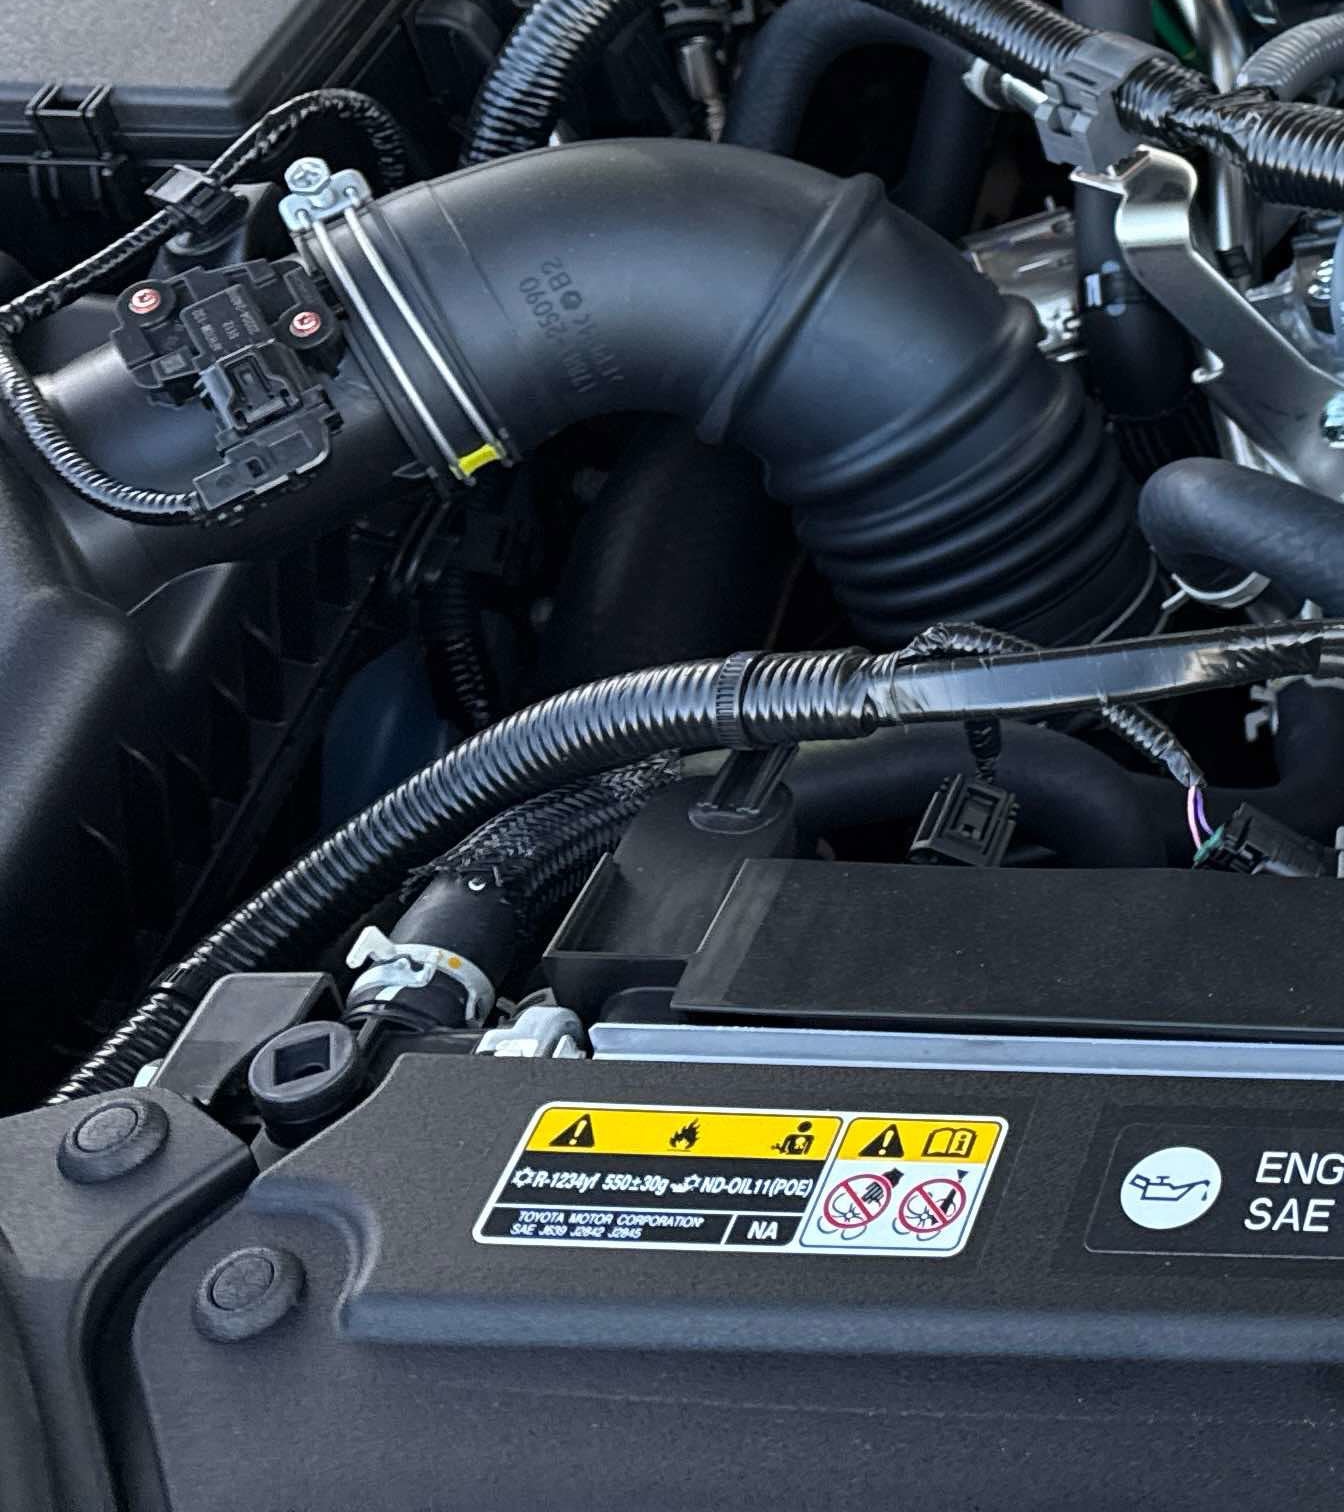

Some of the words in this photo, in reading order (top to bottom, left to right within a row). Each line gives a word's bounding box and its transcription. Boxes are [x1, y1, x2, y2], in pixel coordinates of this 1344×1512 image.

[532, 1171, 600, 1193] R-1234yf
[601, 1173, 669, 1196] 550±30g
[700, 1176, 814, 1199] ND-OIL11(POE)
[518, 1210, 565, 1223] TOYOTA
[568, 1213, 613, 1226] MOTOR
[616, 1215, 705, 1229] CORPORATION
[1244, 1197, 1336, 1233] SAE
[509, 1223, 537, 1236] SAE
[746, 1220, 779, 1240] NA
